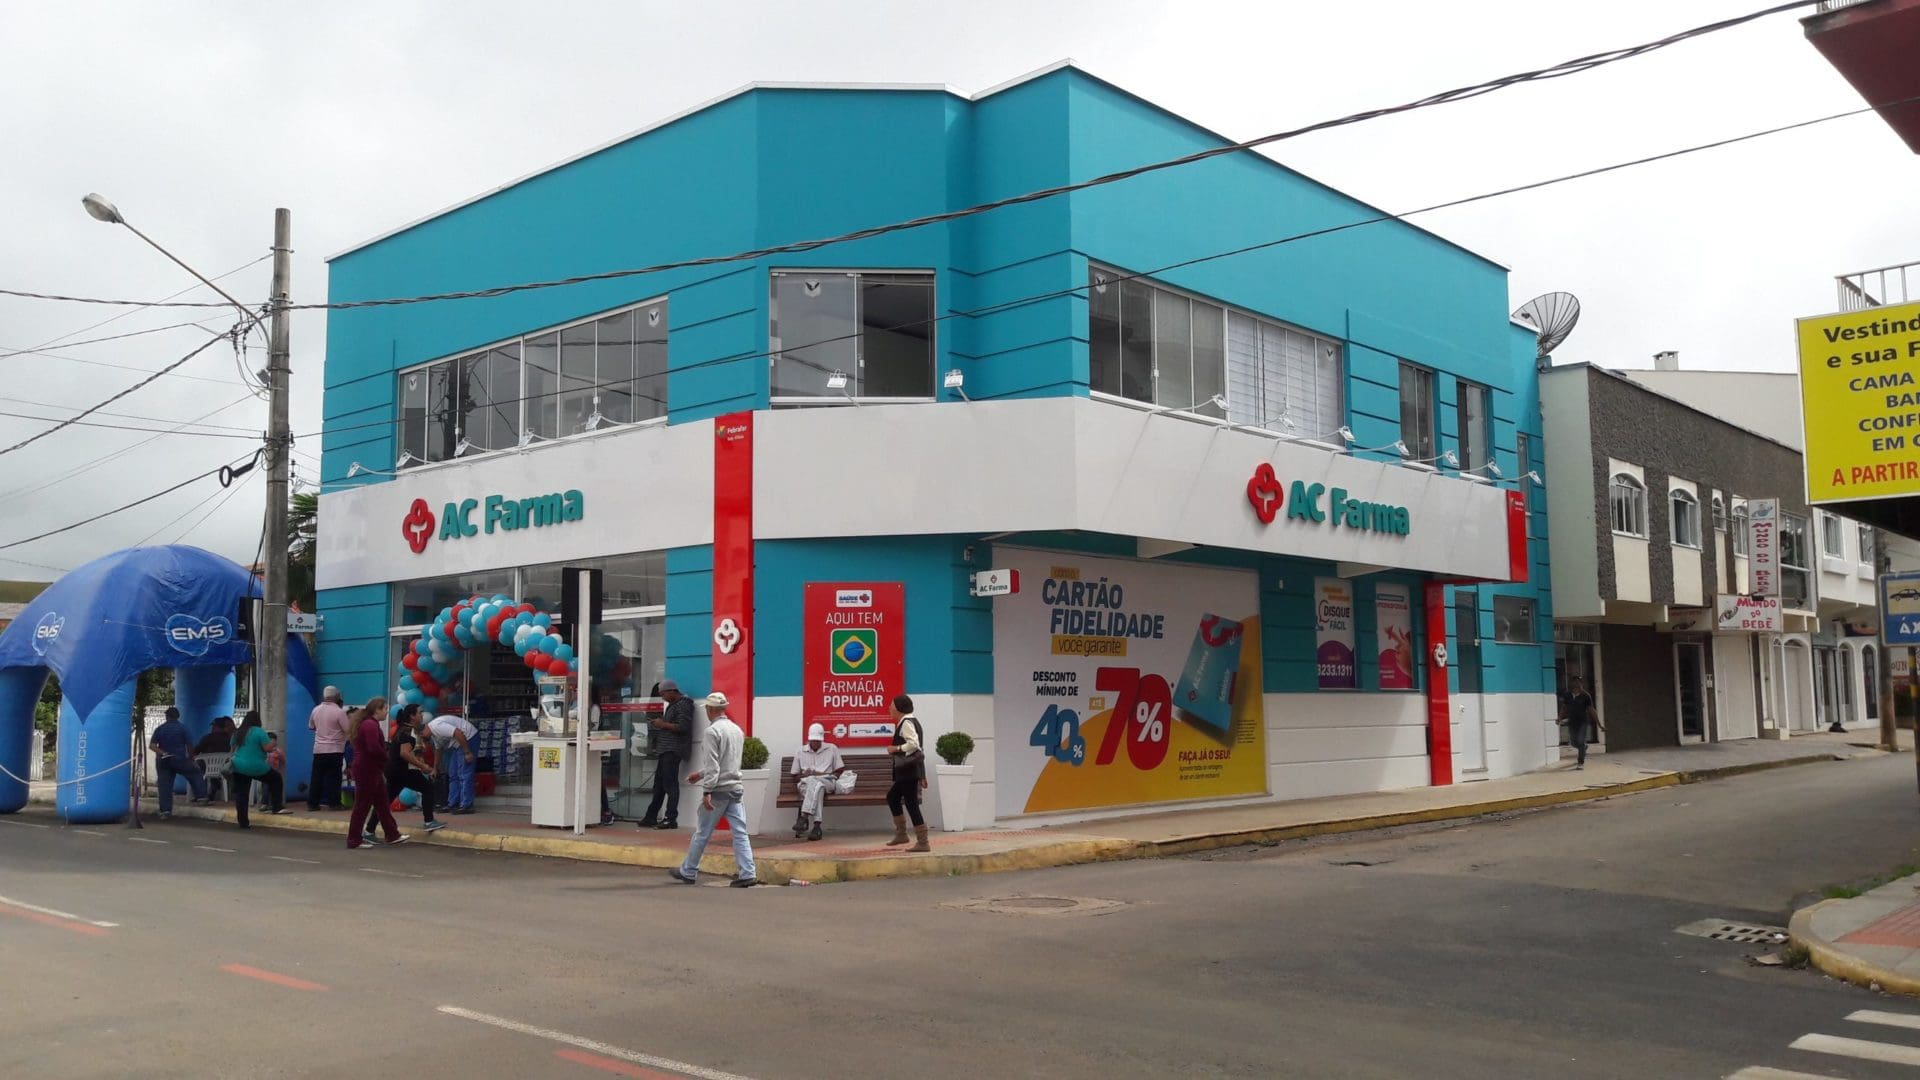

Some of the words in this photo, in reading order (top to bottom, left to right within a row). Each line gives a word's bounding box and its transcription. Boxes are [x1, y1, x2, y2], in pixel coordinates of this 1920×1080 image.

[1827, 355, 1841, 368] e
[1851, 347, 1897, 366] sua
[1849, 372, 1914, 392] CAMA
[1858, 413, 1920, 432] CONF
[1872, 436, 1904, 451] EM
[1832, 468, 1845, 486] A
[1852, 460, 1919, 484] PARTIR
[439, 498, 478, 540] AC
[485, 489, 583, 534] Farma
[1288, 480, 1325, 522] AC
[1331, 487, 1409, 536] Farma
[1042, 576, 1123, 609] CARTÃO
[1736, 598, 1776, 608] MUNDO
[825, 612, 854, 625] AQUI
[858, 612, 883, 624] TEM
[1323, 605, 1350, 618] DISQUE
[1751, 610, 1761, 618] DO
[37, 624, 60, 638] EMS
[1050, 608, 1164, 639] FIDELIDADE
[1330, 618, 1346, 631] FÁCIL
[171, 624, 225, 640] EMS
[1058, 636, 1083, 653] você
[1084, 639, 1121, 657] garante
[822, 677, 884, 692] FARMÁCIA
[1033, 671, 1076, 682] DESCONTO
[1036, 683, 1067, 696] MÍNIMO
[1068, 686, 1078, 696] DE
[823, 695, 884, 707] POPULAR
[1178, 750, 1197, 764] FAÇA
[1199, 748, 1207, 760] JÁ
[1208, 750, 1214, 760] O
[1215, 749, 1231, 760] SEU!
[76, 730, 88, 805] genéricos
